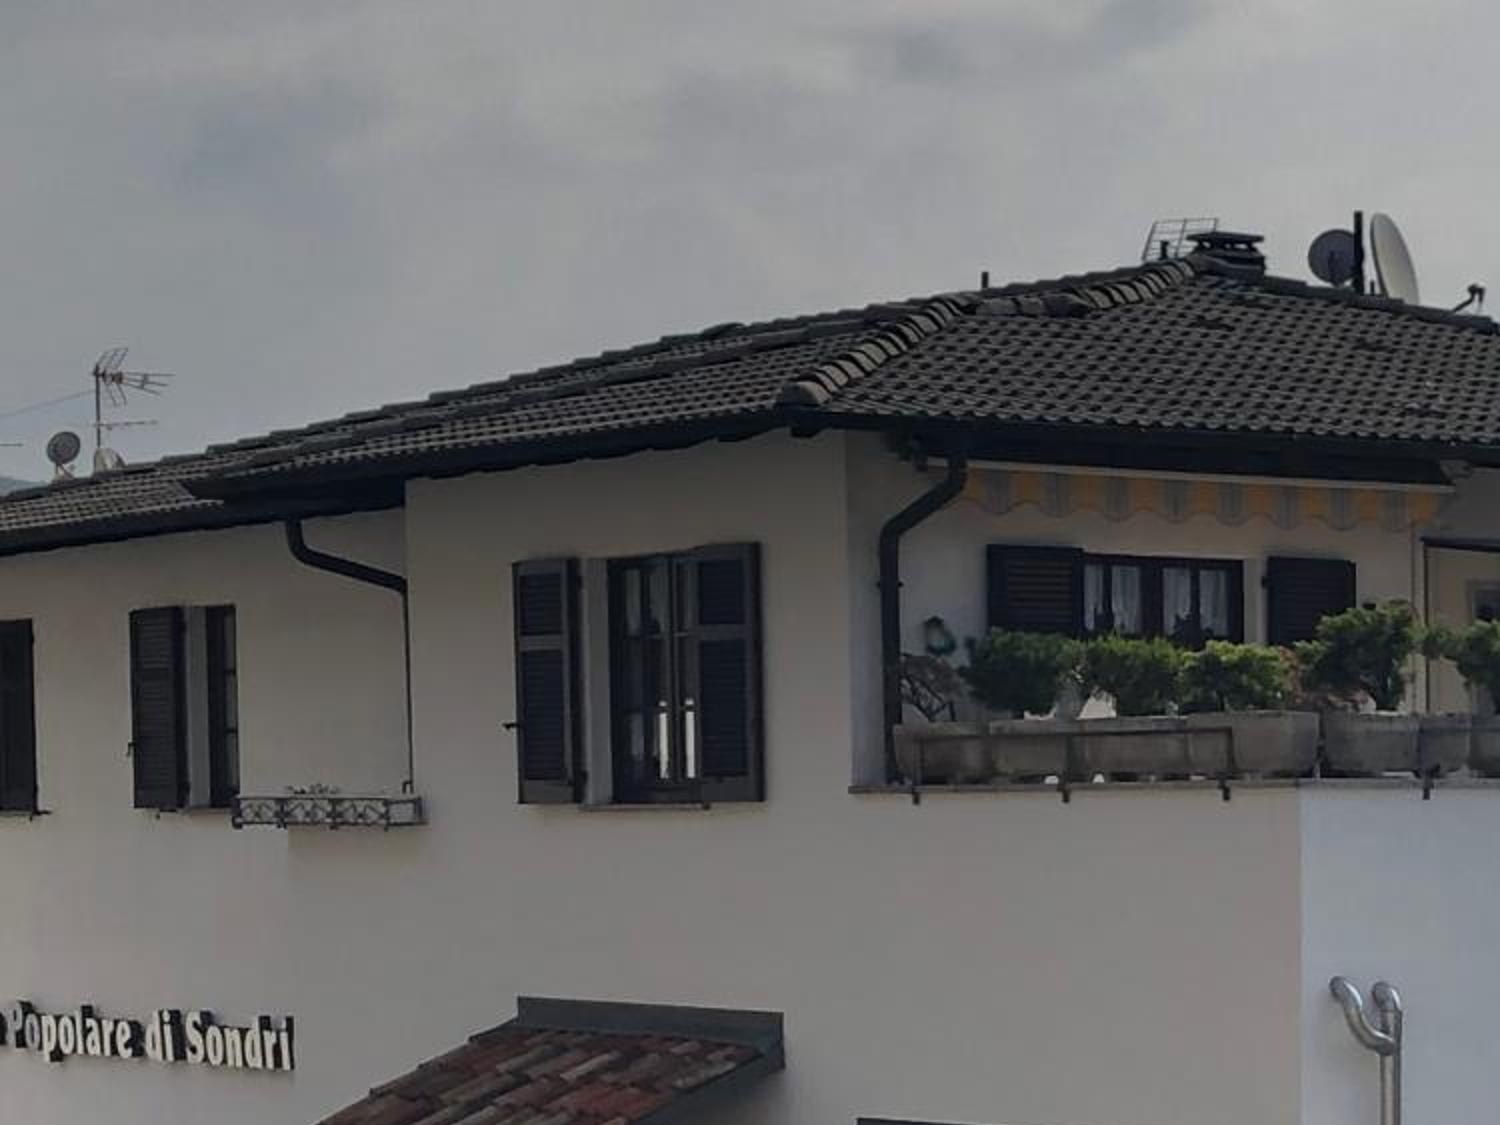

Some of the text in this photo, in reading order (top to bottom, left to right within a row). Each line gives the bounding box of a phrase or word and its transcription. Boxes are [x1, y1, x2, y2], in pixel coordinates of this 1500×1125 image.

[6, 999, 294, 1071] Popolare di Sondri
